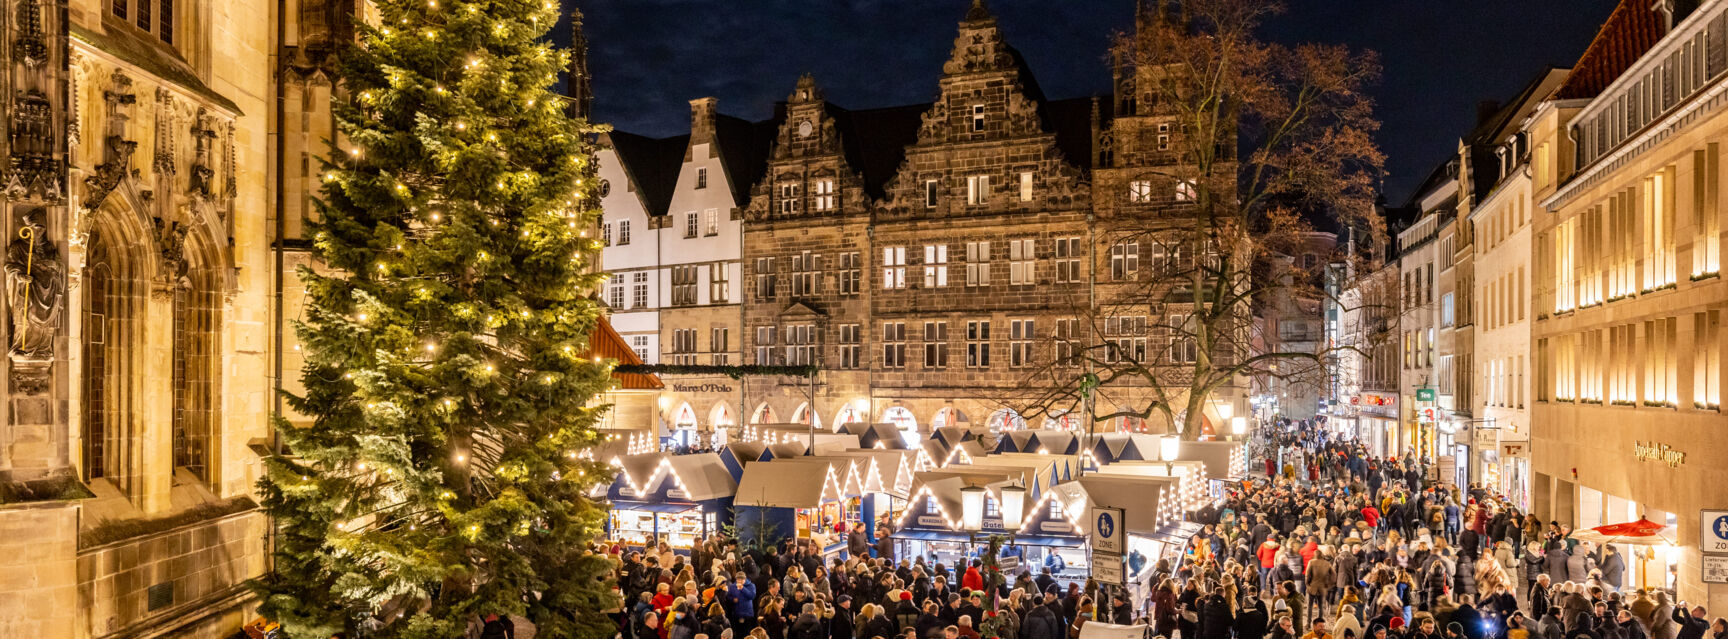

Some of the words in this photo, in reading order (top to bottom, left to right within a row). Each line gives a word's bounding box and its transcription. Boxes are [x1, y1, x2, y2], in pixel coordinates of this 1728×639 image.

[673, 384, 698, 392] Marc
[700, 384, 732, 392] O'Polo
[1420, 391, 1432, 399] Tee
[1099, 540, 1113, 549] ZONE
